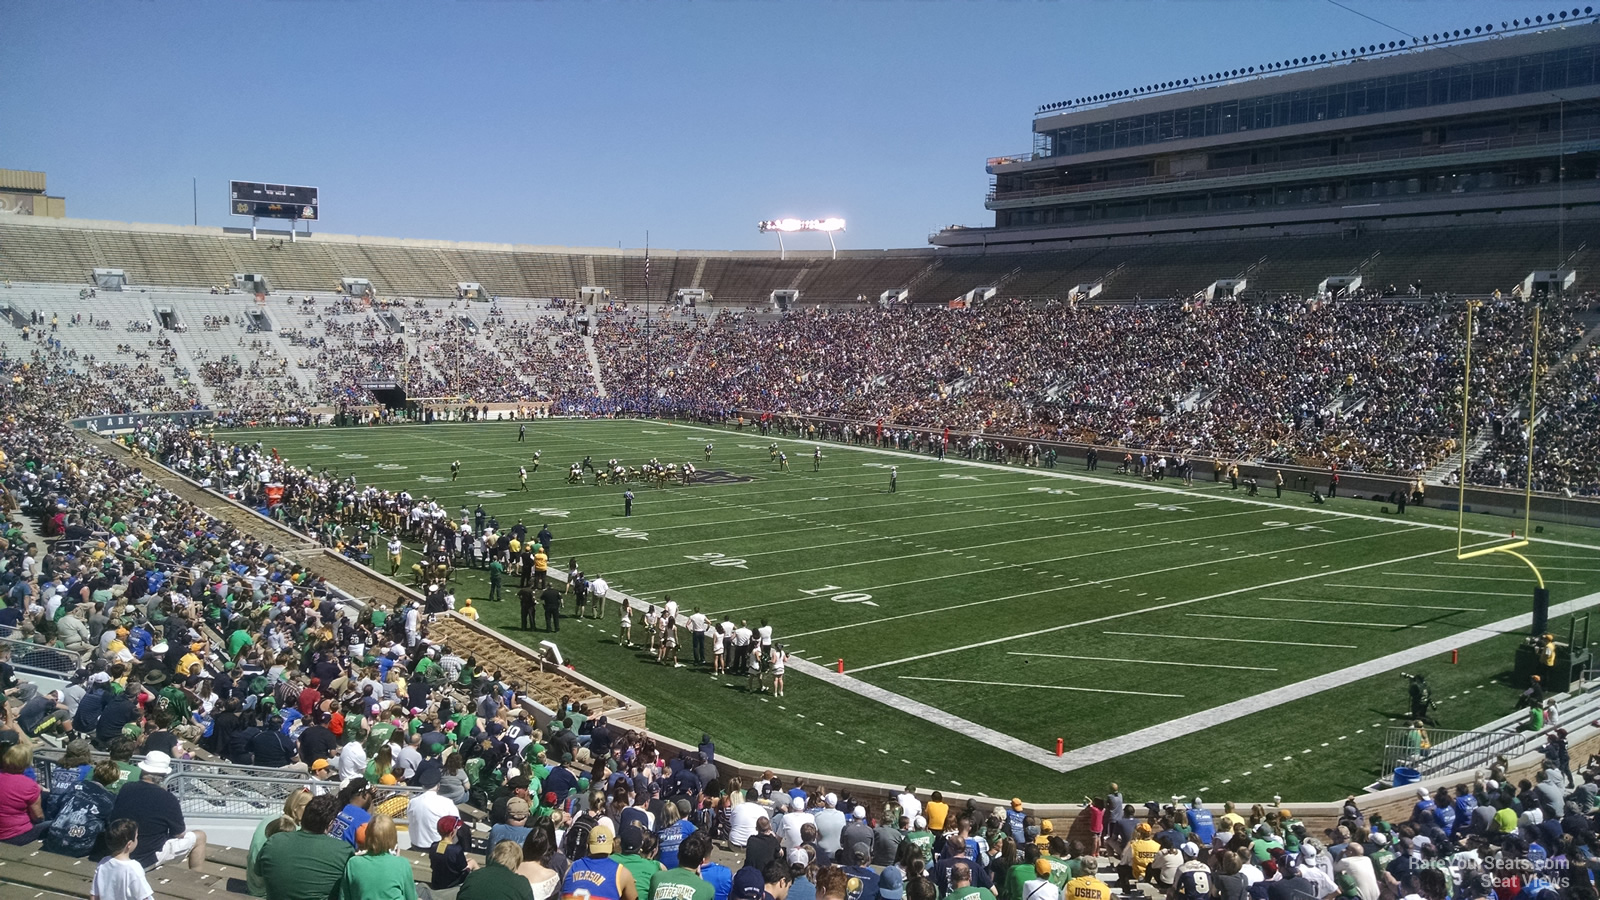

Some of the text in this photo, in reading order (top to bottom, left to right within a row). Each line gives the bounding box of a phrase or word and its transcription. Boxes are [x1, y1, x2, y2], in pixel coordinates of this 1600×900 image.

[107, 416, 134, 426] ARE
[597, 527, 649, 539] 30
[684, 552, 747, 567] 20
[798, 585, 872, 603] 10
[573, 870, 606, 887] IVERSON
[1193, 871, 1210, 894] 9
[655, 885, 694, 899] NOTRE DAME
[1075, 887, 1102, 900] USHER
